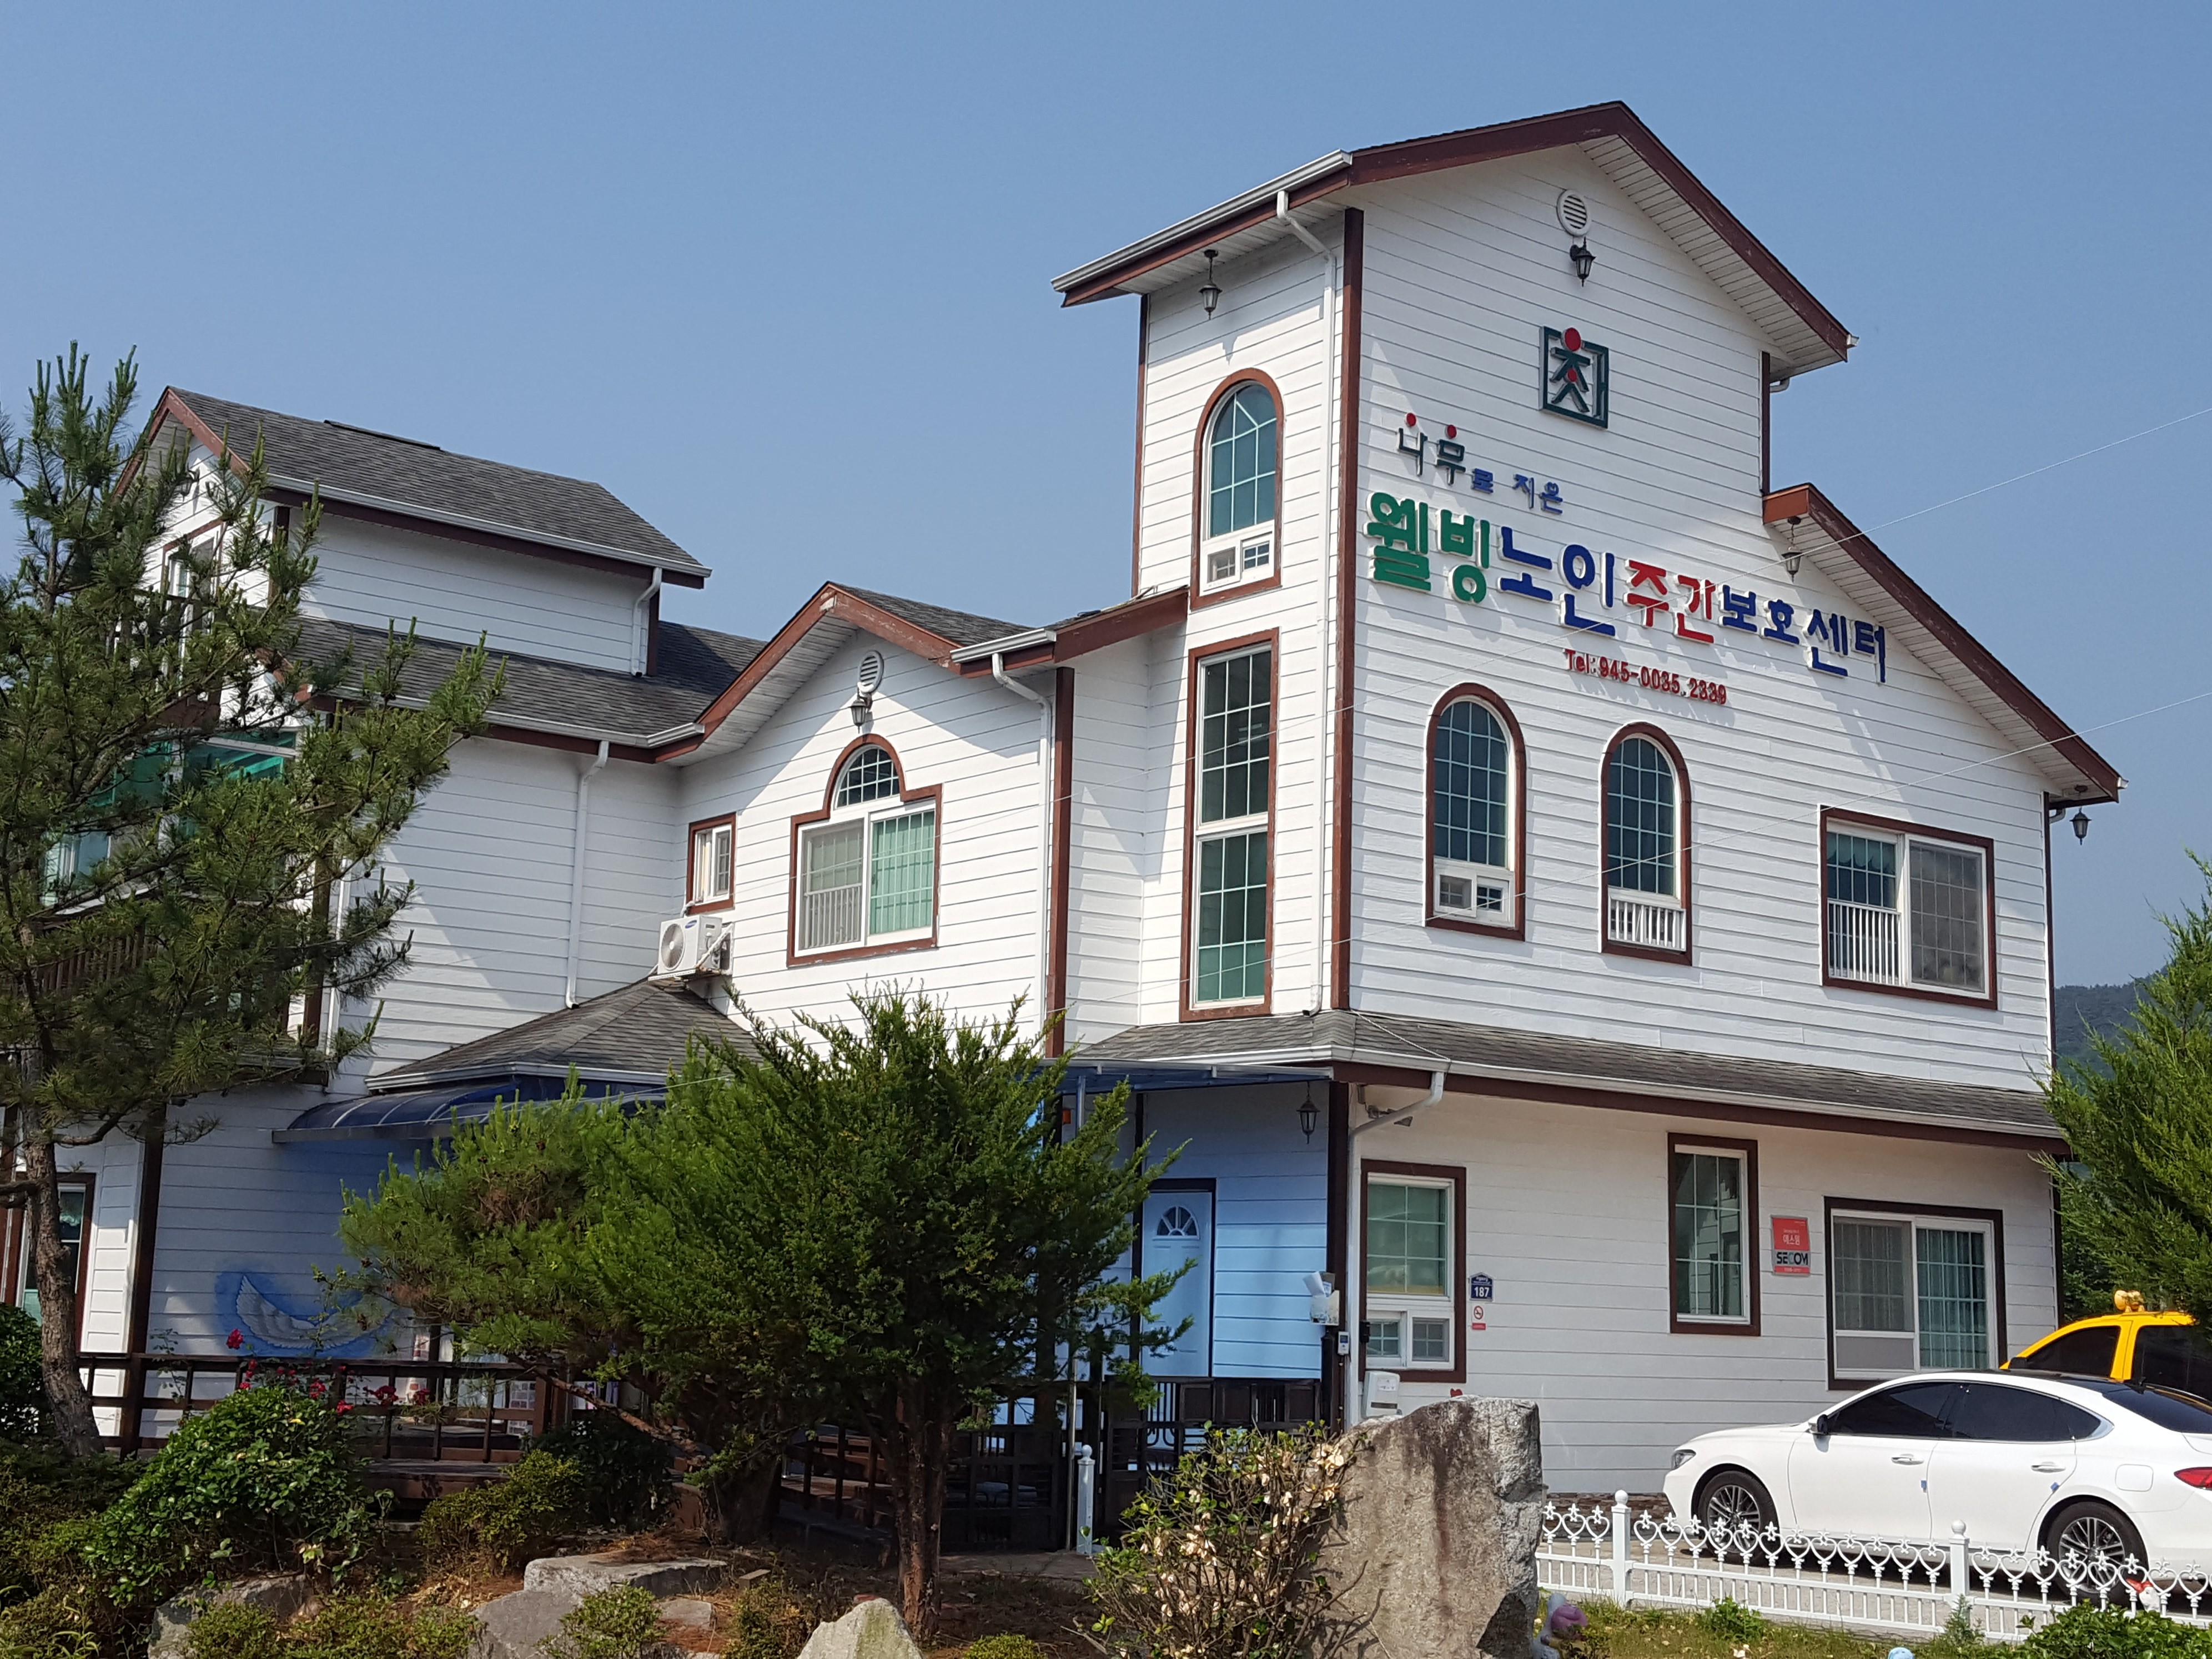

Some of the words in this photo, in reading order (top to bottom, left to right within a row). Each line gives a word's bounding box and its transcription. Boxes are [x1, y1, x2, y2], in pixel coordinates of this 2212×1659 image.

[1512, 473, 1564, 515] 지은
[1776, 1251, 1809, 1265] SECOM
[1474, 1286, 1490, 1298] 187
